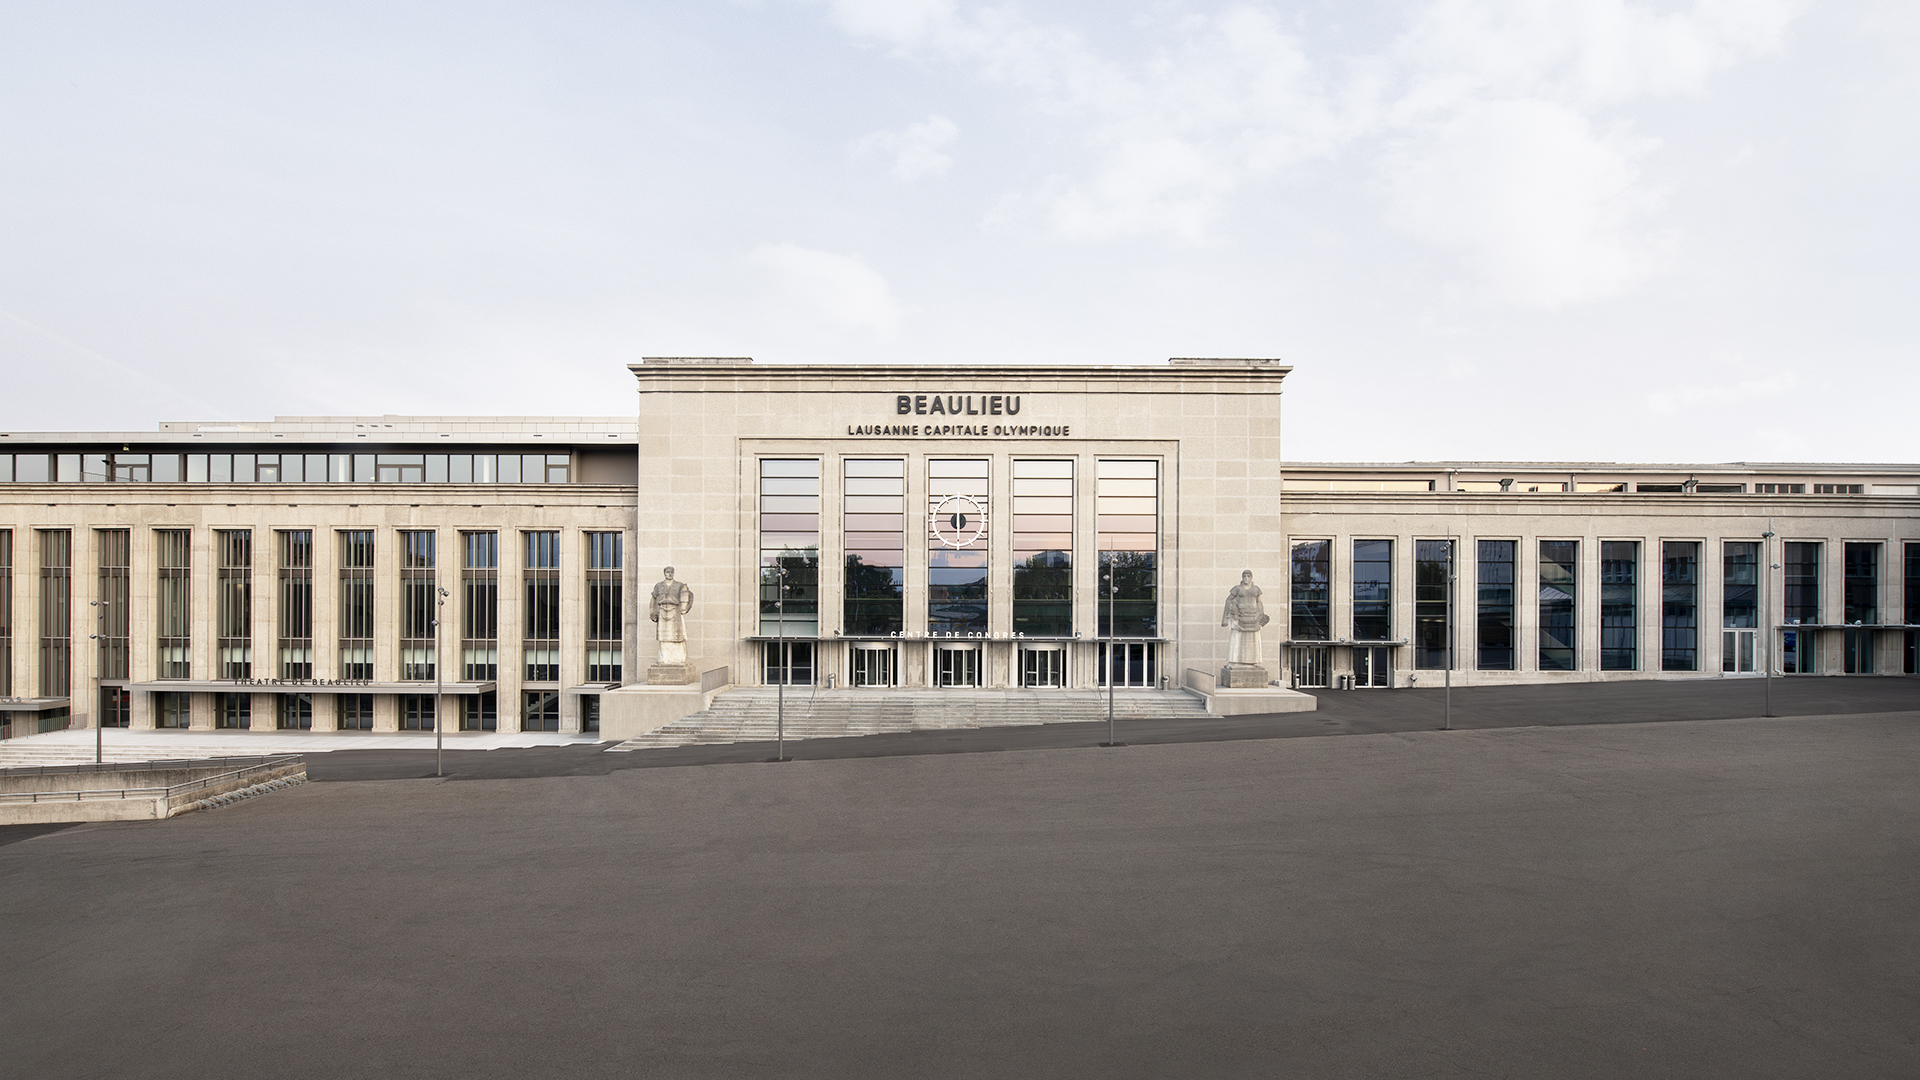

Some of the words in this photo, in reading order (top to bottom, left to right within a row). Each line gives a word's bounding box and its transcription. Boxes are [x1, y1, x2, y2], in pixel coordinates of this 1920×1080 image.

[896, 395, 1021, 415] BEAULIEU
[848, 425, 919, 436] LAUSANNE
[924, 425, 989, 436] CAPITALE
[993, 425, 1070, 437] OLYMPIQUE
[890, 630, 938, 639] CENTRE
[945, 631, 960, 639] DE
[967, 631, 1025, 639] CONGRES
[234, 678, 285, 686] THEATRE
[291, 678, 305, 686] DE
[312, 678, 369, 686] BEAULIEU
